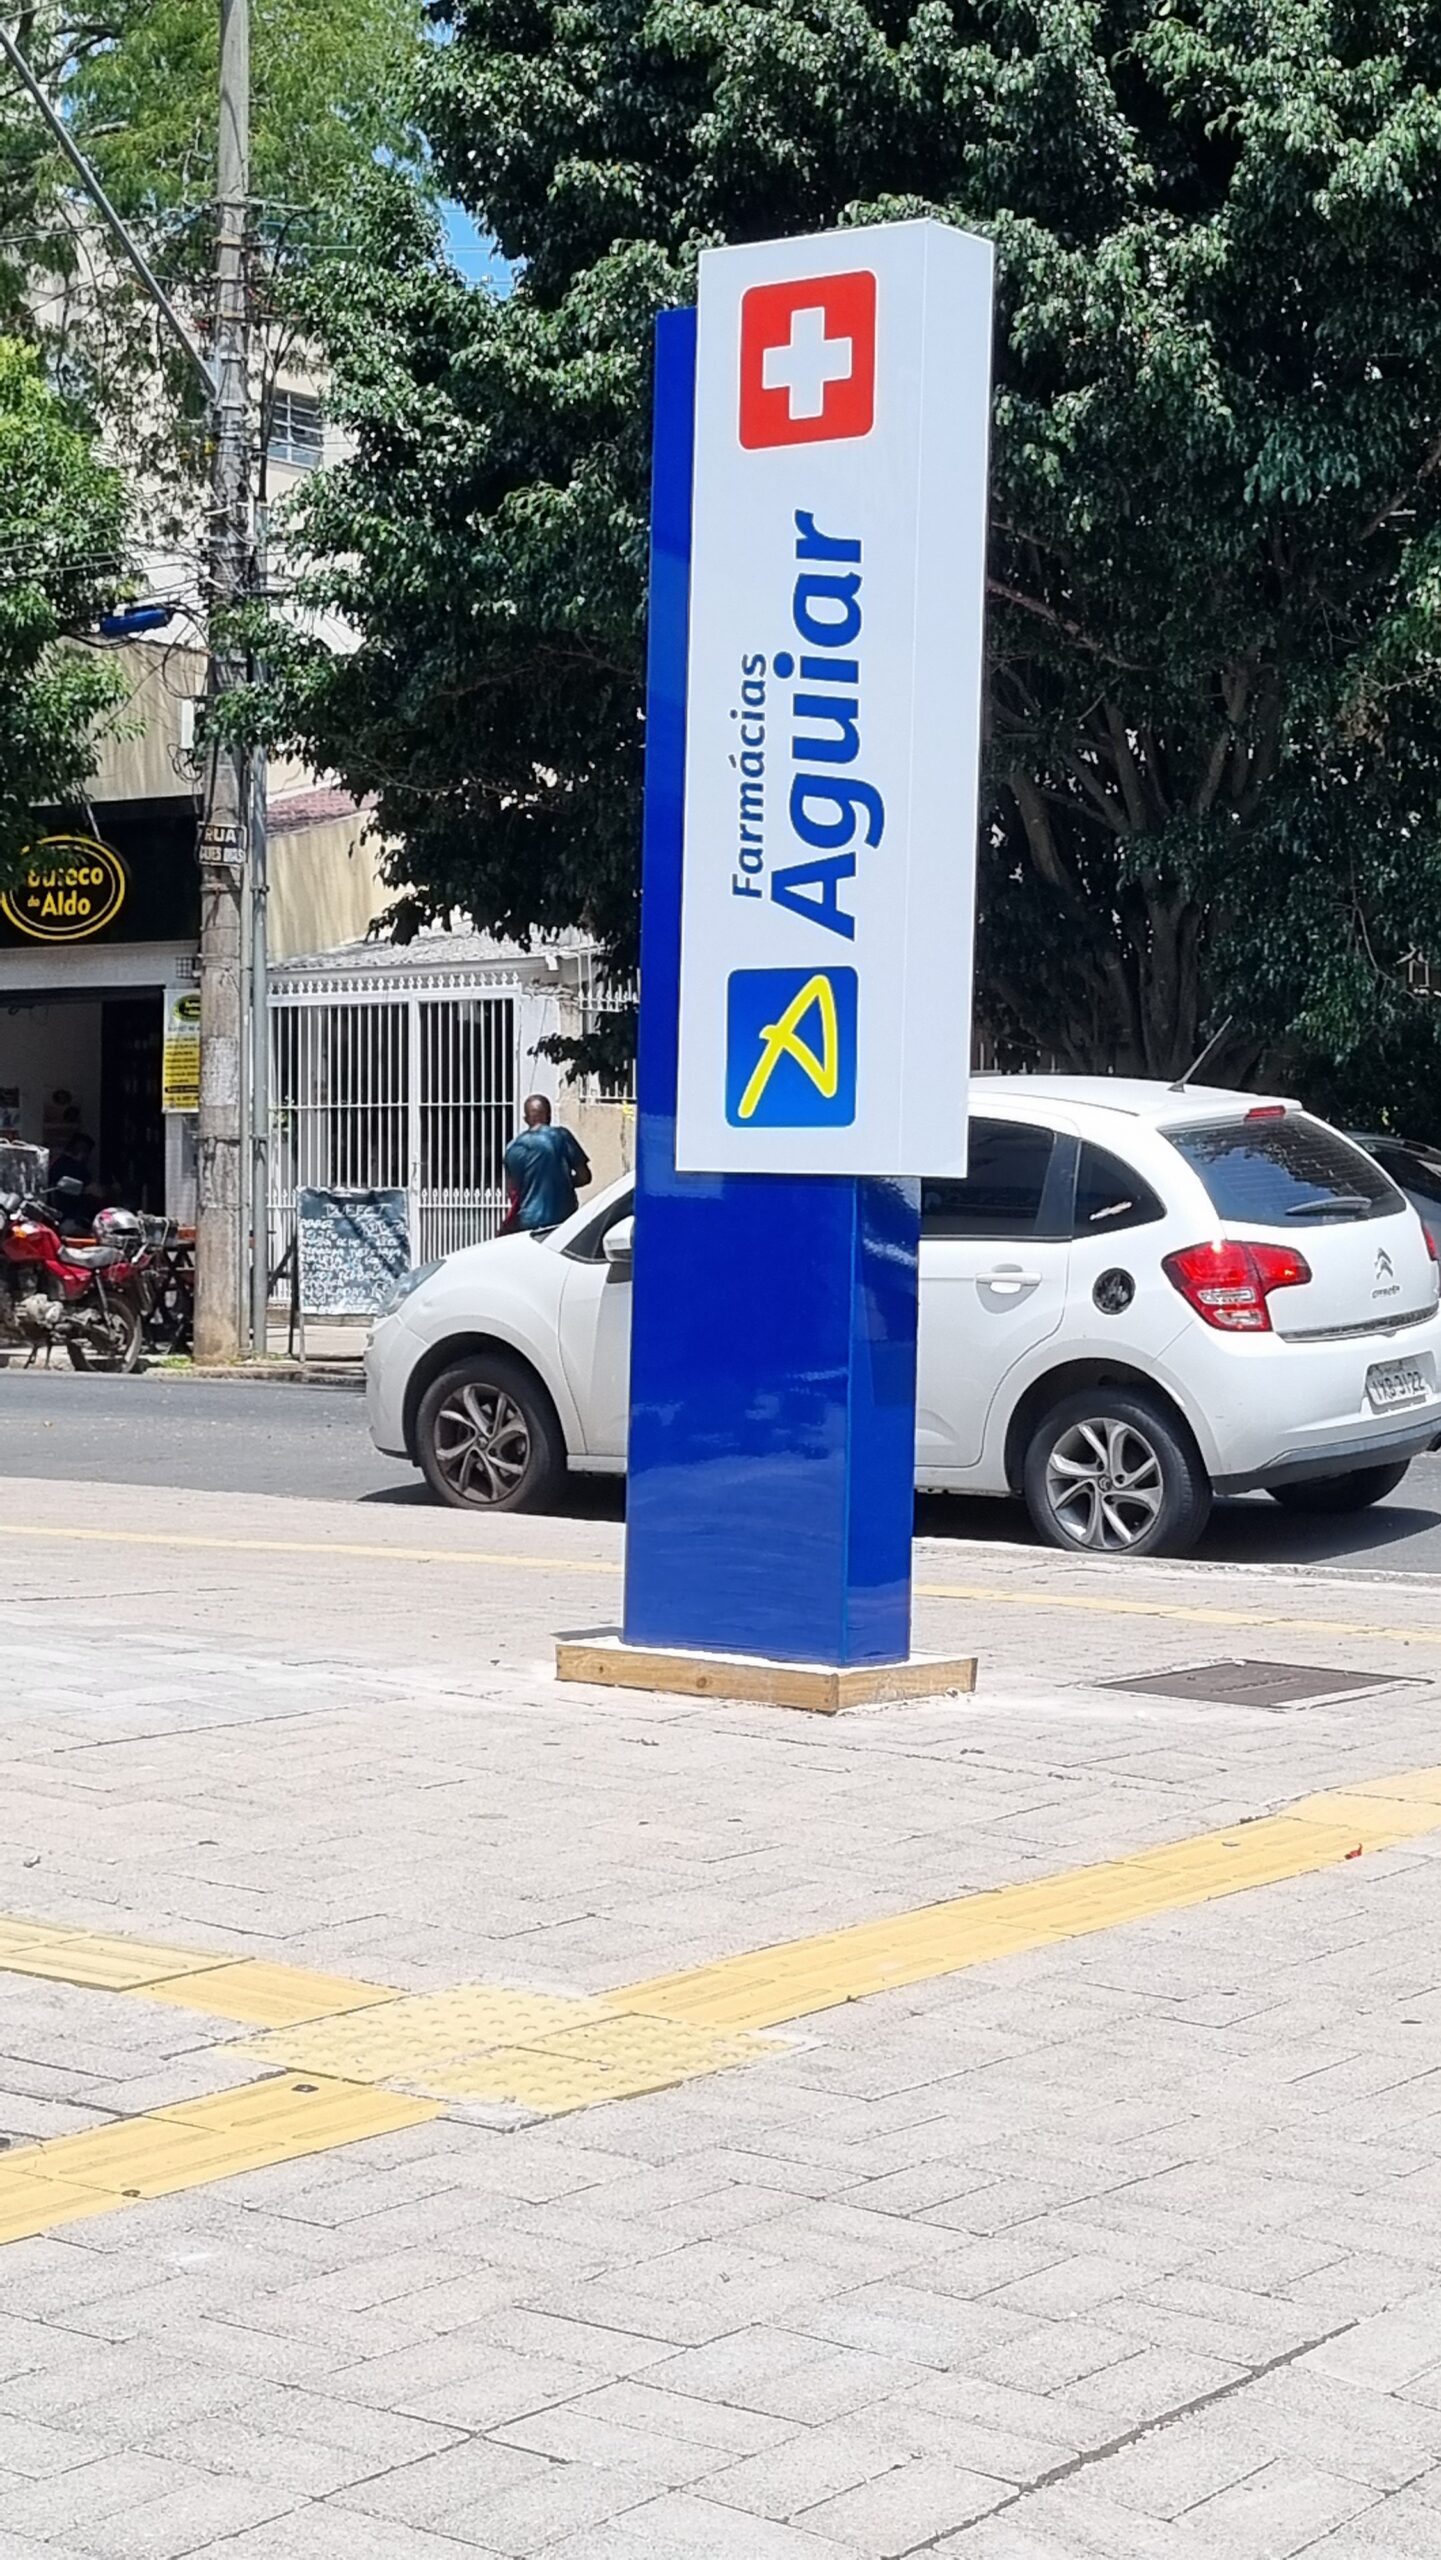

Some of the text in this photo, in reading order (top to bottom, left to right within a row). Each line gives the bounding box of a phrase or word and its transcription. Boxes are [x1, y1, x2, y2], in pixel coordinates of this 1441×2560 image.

[729, 652, 767, 899] Farmácias
[770, 509, 885, 942] Aguiar
[40, 890, 92, 917] Aldo
[204, 827, 237, 843] RUA
